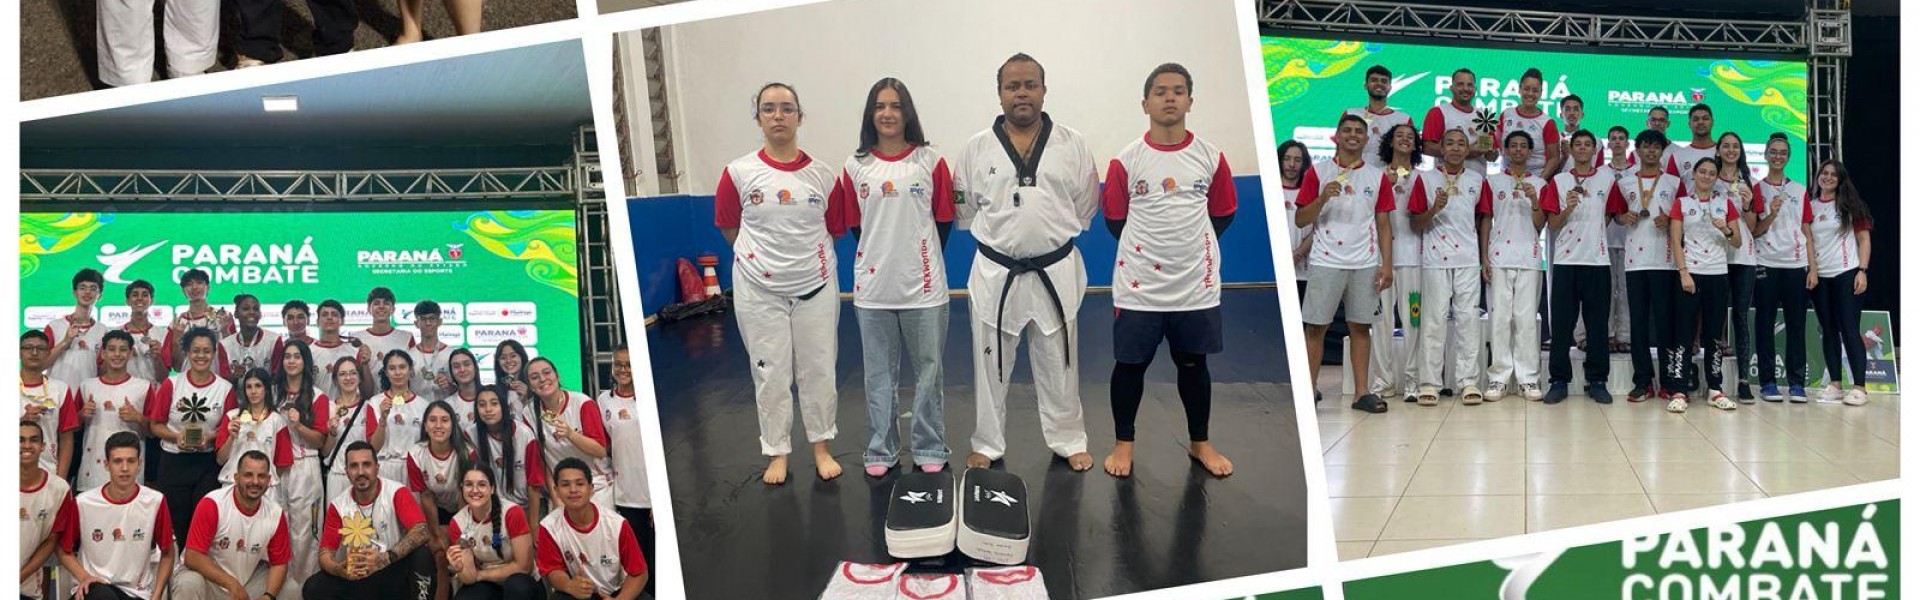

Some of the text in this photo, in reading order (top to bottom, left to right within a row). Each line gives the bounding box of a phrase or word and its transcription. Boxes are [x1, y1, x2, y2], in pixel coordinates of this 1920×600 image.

[1608, 90, 1687, 103] PARANÁ
[172, 236, 319, 265] PARANÁ
[357, 248, 444, 263] PARANÁ
[1622, 503, 1888, 569] PARANÁ
